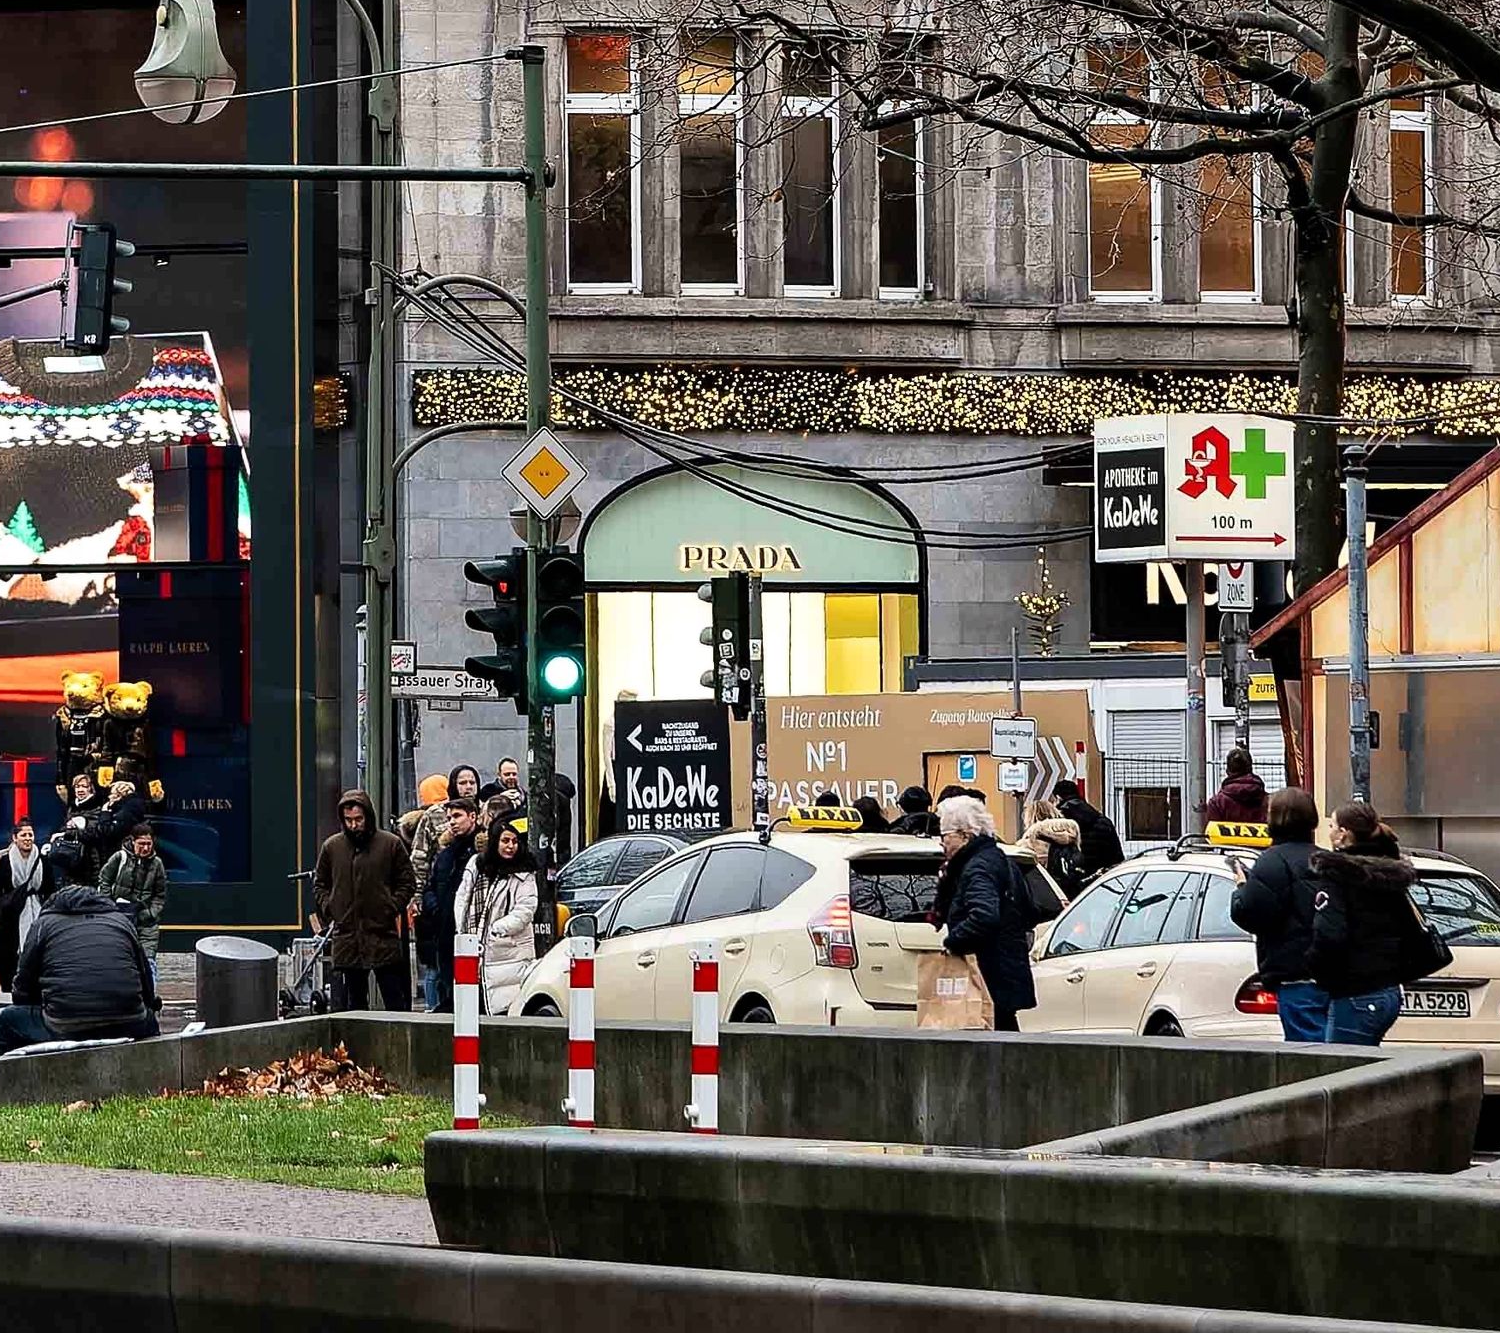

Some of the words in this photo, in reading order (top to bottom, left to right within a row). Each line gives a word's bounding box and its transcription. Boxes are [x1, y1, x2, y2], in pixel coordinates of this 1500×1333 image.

[1104, 467, 1146, 488] APOTHEKE
[1147, 467, 1158, 485] im
[1104, 494, 1158, 528] KaDeWe
[1211, 515, 1235, 529] 100
[1240, 518, 1252, 529] m
[683, 546, 802, 569] PRADA
[1226, 583, 1245, 601] ZONE
[130, 642, 163, 655] RALPH
[169, 641, 210, 654] LAUREN
[398, 675, 450, 688] assauer
[781, 706, 816, 729] Hier
[818, 706, 882, 729] entsteht
[930, 709, 966, 726] Zugang
[626, 765, 719, 809] KaDeWe
[767, 779, 900, 810] PASSAUER
[182, 798, 233, 810] LAUREN
[627, 814, 651, 830] DIE
[654, 812, 721, 831] SECHSTE
[807, 807, 854, 821] TAXI
[1229, 824, 1269, 837] TAX
[1427, 992, 1467, 1010] 5298
